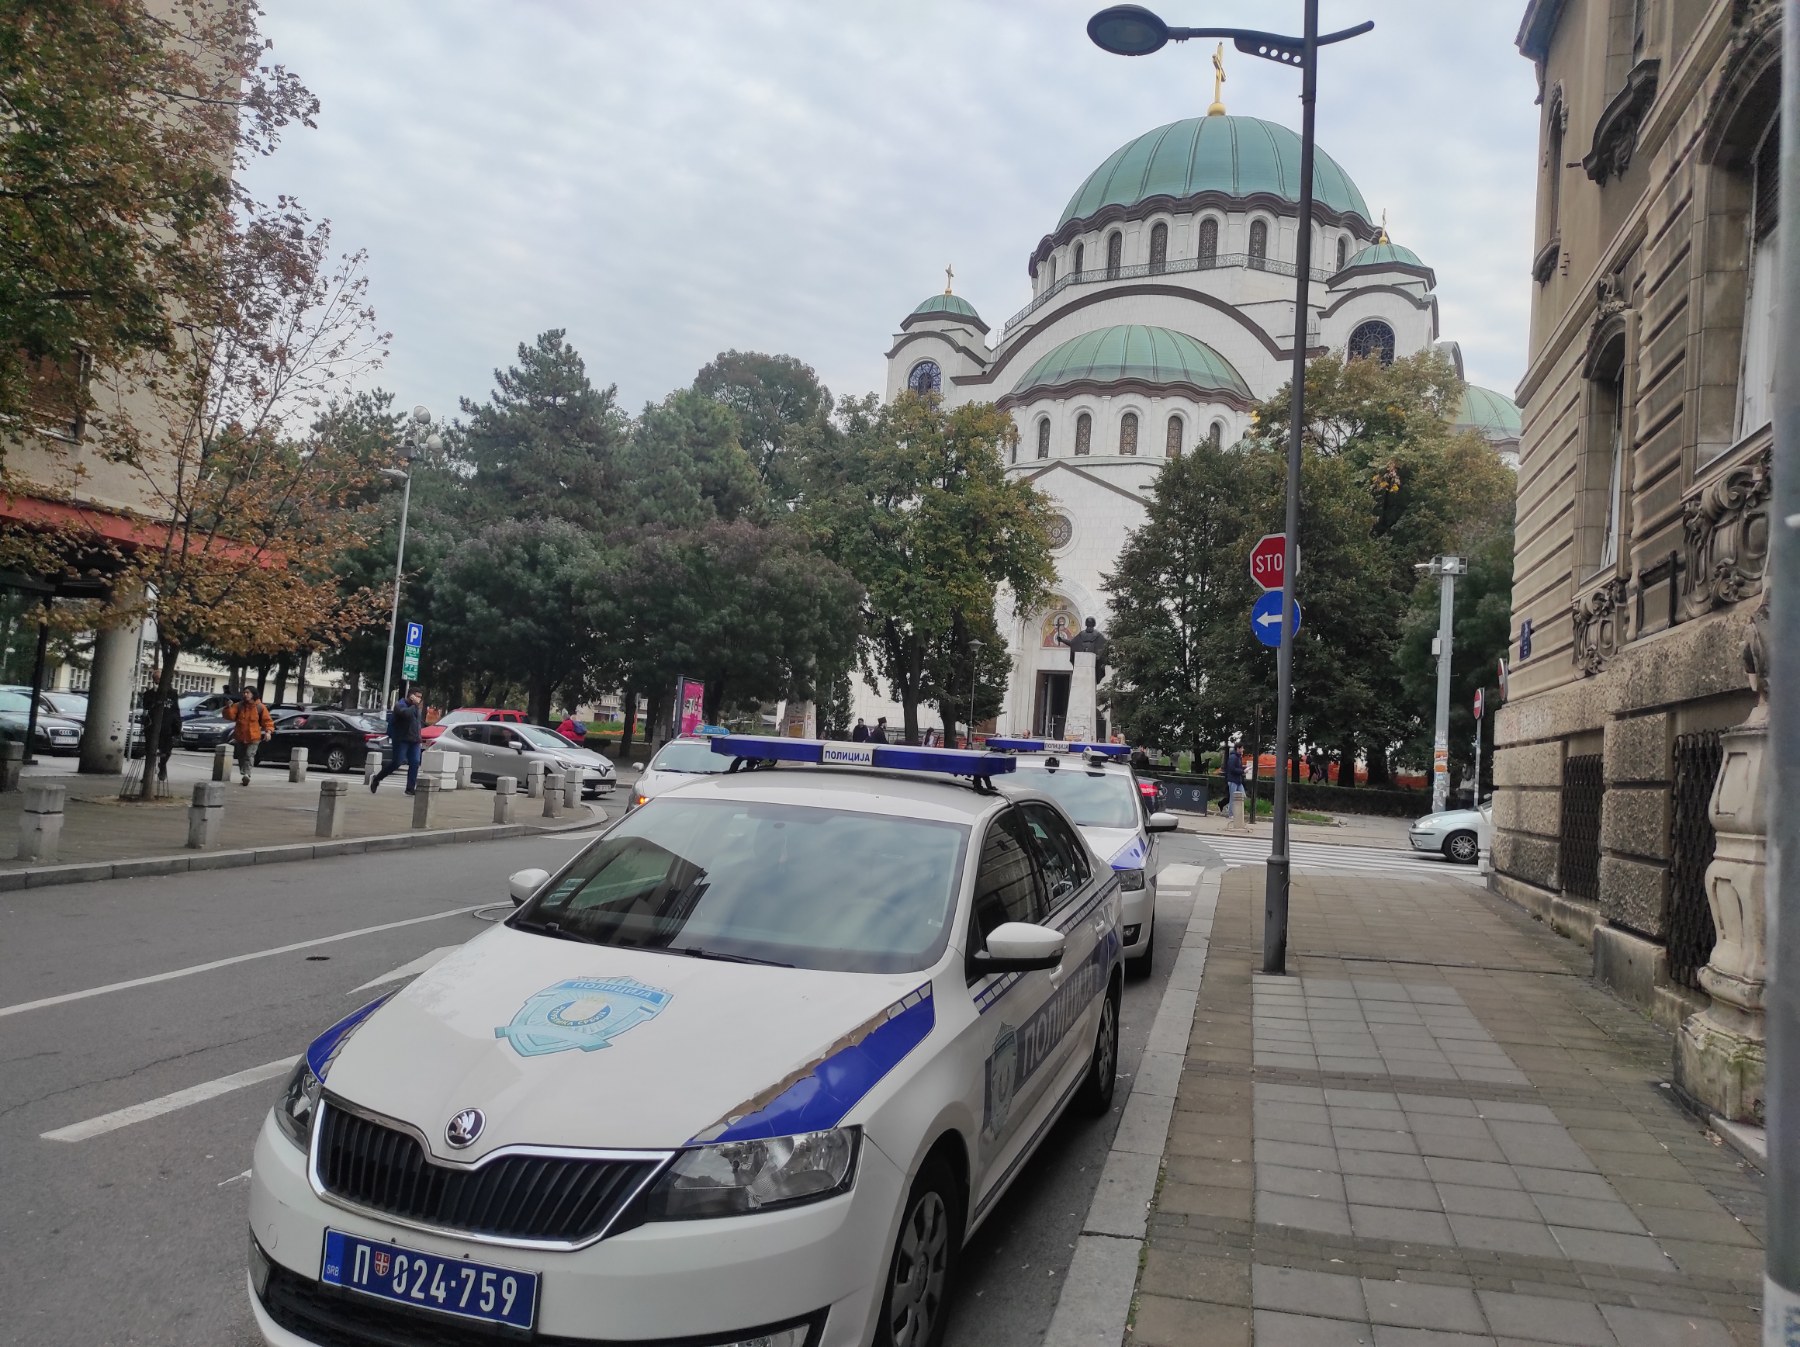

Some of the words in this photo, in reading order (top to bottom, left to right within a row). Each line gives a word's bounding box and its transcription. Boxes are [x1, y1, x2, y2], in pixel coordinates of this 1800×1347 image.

[1256, 553, 1283, 573] STO
[410, 626, 419, 643] P
[825, 750, 870, 762] ПОЛИЦИЈА
[572, 982, 652, 998] ПОЛИЦИЈА
[1023, 960, 1093, 1077] ПОЛИЦИЈА
